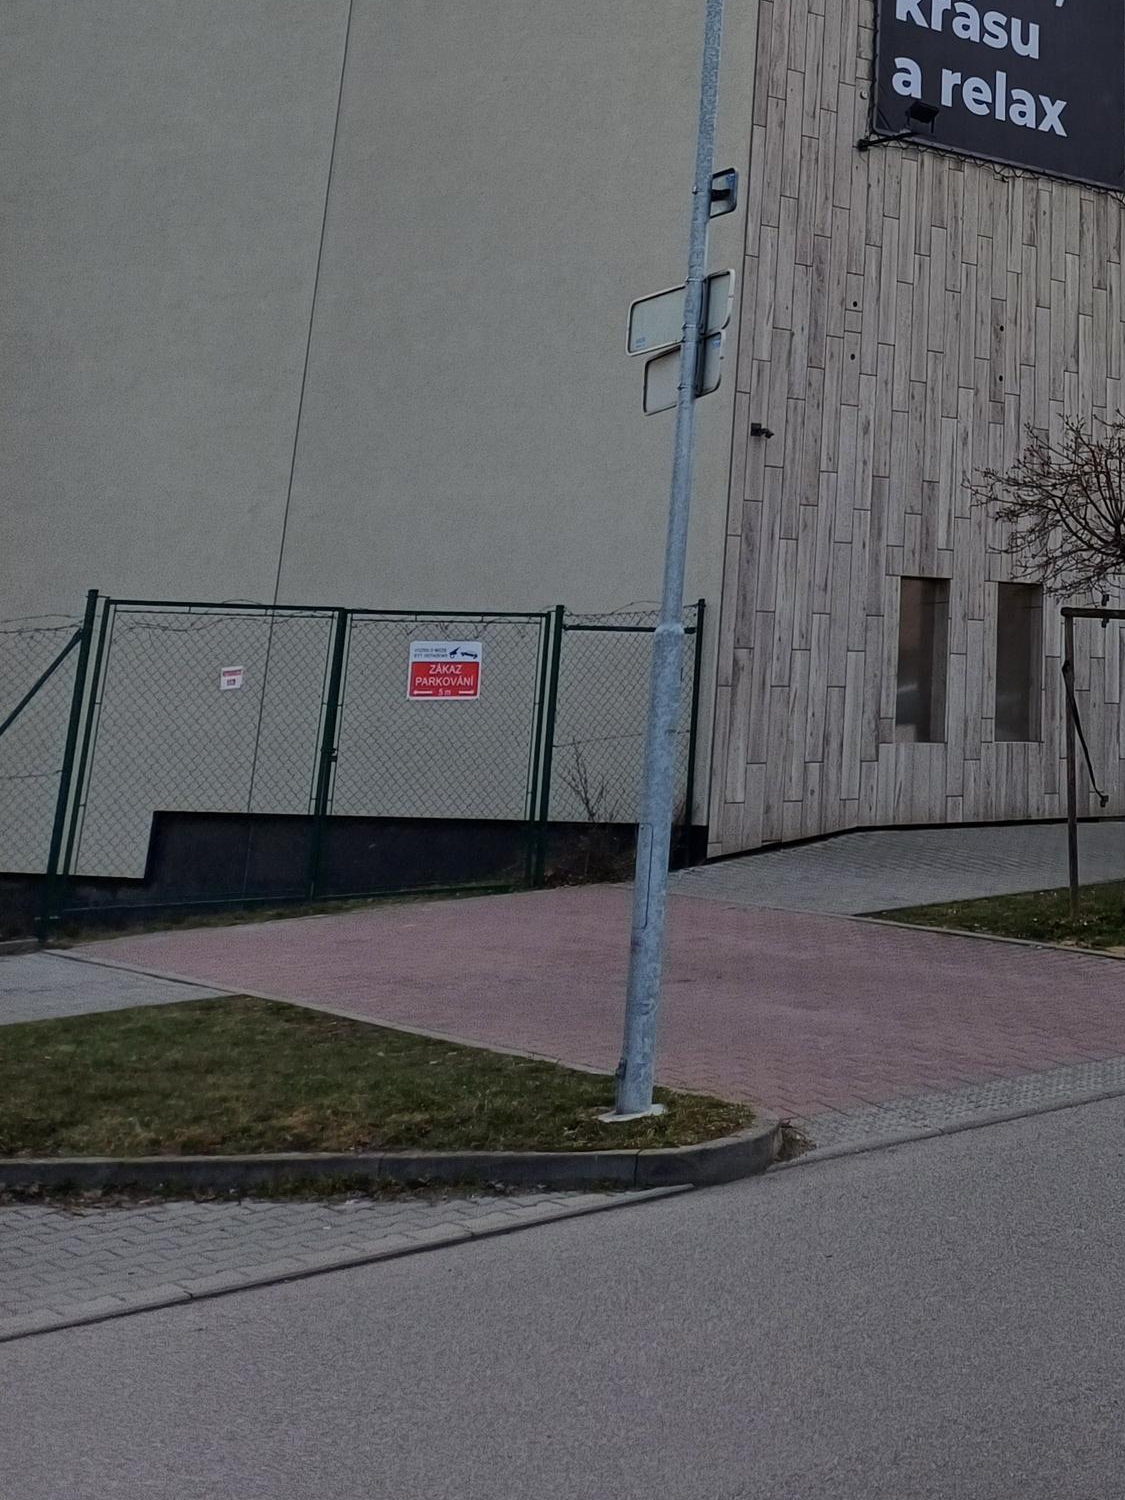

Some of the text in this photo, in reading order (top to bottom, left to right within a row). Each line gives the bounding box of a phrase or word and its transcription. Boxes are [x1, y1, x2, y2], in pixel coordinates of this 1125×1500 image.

[892, 57, 1068, 137] a relax
[429, 663, 462, 674] ZÁKAZ
[415, 676, 473, 687] PARKOVÁNÍ
